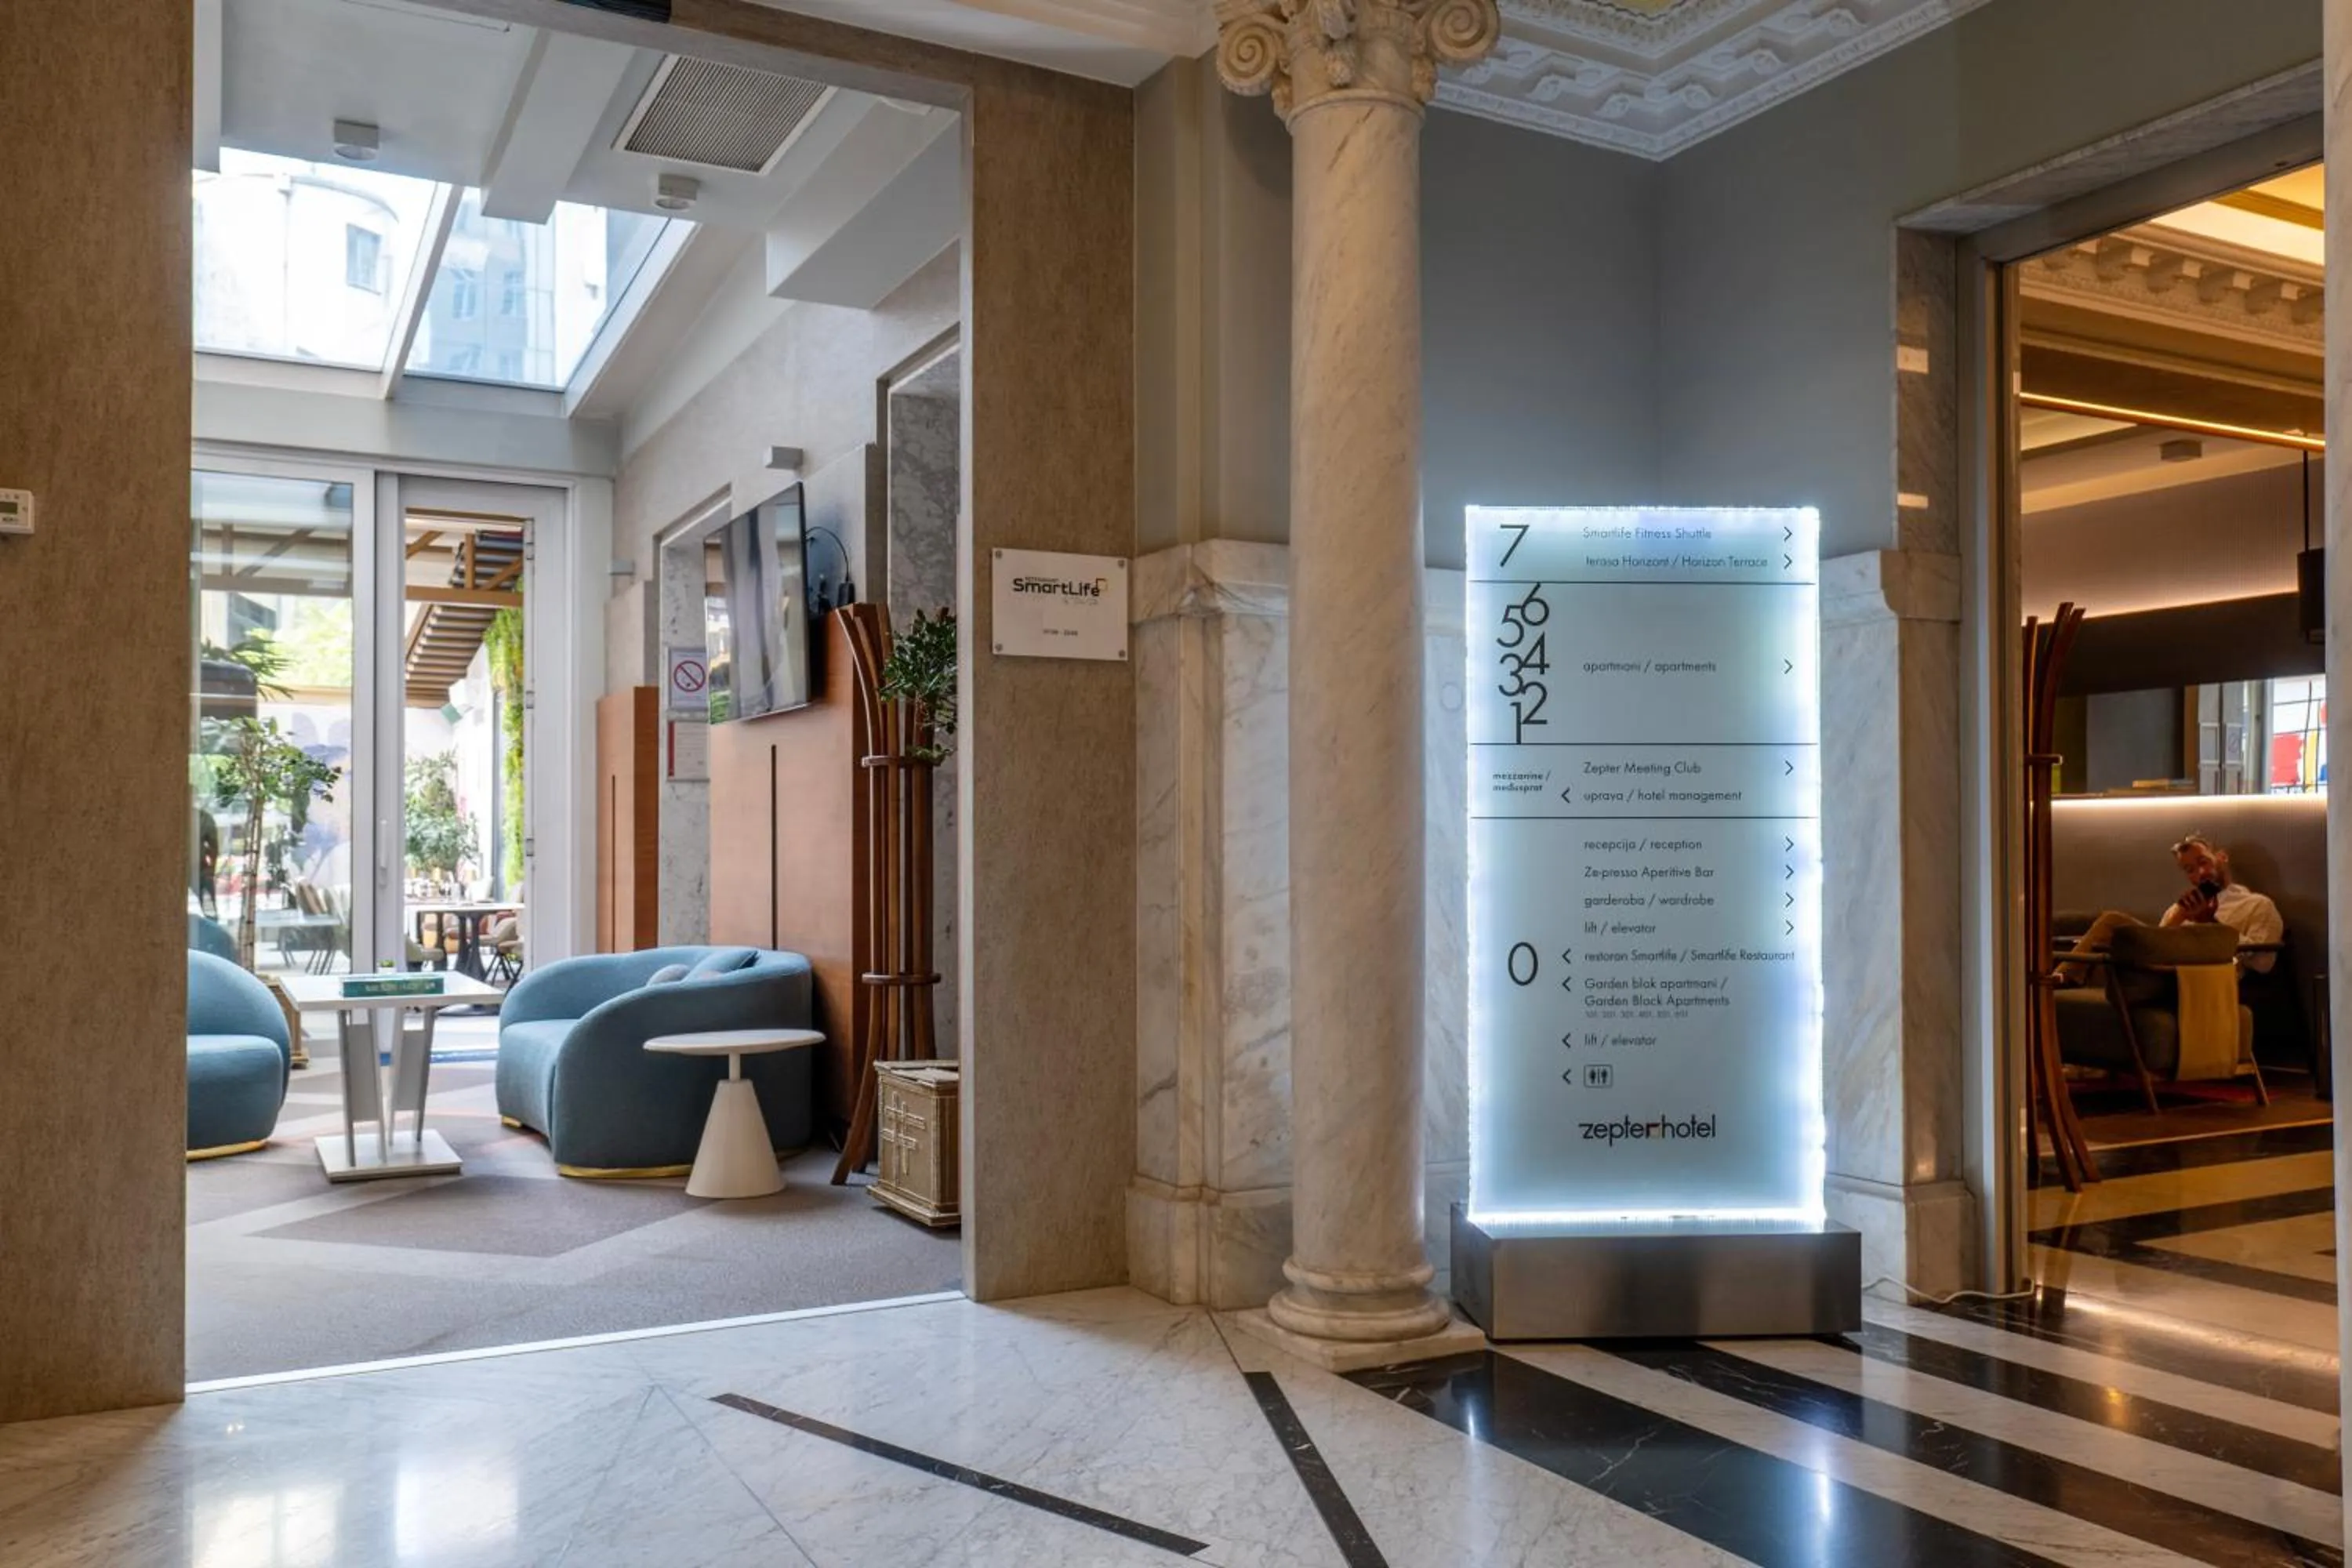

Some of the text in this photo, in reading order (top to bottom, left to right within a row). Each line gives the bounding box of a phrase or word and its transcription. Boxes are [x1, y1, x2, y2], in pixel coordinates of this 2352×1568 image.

[1635, 526, 1671, 539] Fitness
[1675, 526, 1711, 540] Shuttle
[1499, 524, 1530, 568] 7
[1682, 554, 1726, 568] Horizon
[1727, 555, 1768, 567] Terrace
[1013, 578, 1101, 597] SmartLife
[1520, 581, 1550, 626] 6
[1496, 604, 1525, 648] 5
[1520, 631, 1550, 675] 4
[1498, 652, 1525, 697] 3
[1654, 660, 1716, 673] apartments
[1521, 681, 1548, 725] 2
[1509, 702, 1522, 746] 1
[1583, 760, 1702, 776] Zepter Meeting Club
[1583, 792, 1624, 803] uprava
[1638, 788, 1666, 801] hotel
[1668, 790, 1743, 803] management
[1584, 839, 1637, 853] recepcija
[1650, 839, 1703, 852] reception
[1641, 865, 1691, 881] Aperitive
[1694, 865, 1715, 878] Bar
[1584, 893, 1645, 908] garderoba
[1658, 892, 1715, 906] wardrobe
[1584, 921, 1597, 934] lift
[1611, 921, 1657, 935] elevator
[1584, 951, 1628, 962] restoran
[1631, 949, 1677, 962] Smartlife
[1690, 948, 1737, 962] Smartlife
[1739, 949, 1795, 962] Restaurant
[1508, 942, 1539, 986] 0
[1584, 977, 1628, 990] Garden
[1632, 977, 1657, 989] blok
[1660, 978, 1717, 992] apartmani
[1584, 993, 1730, 1008] Garden Block Apartments
[1584, 1034, 1597, 1047] lift
[1611, 1034, 1657, 1047] elevator
